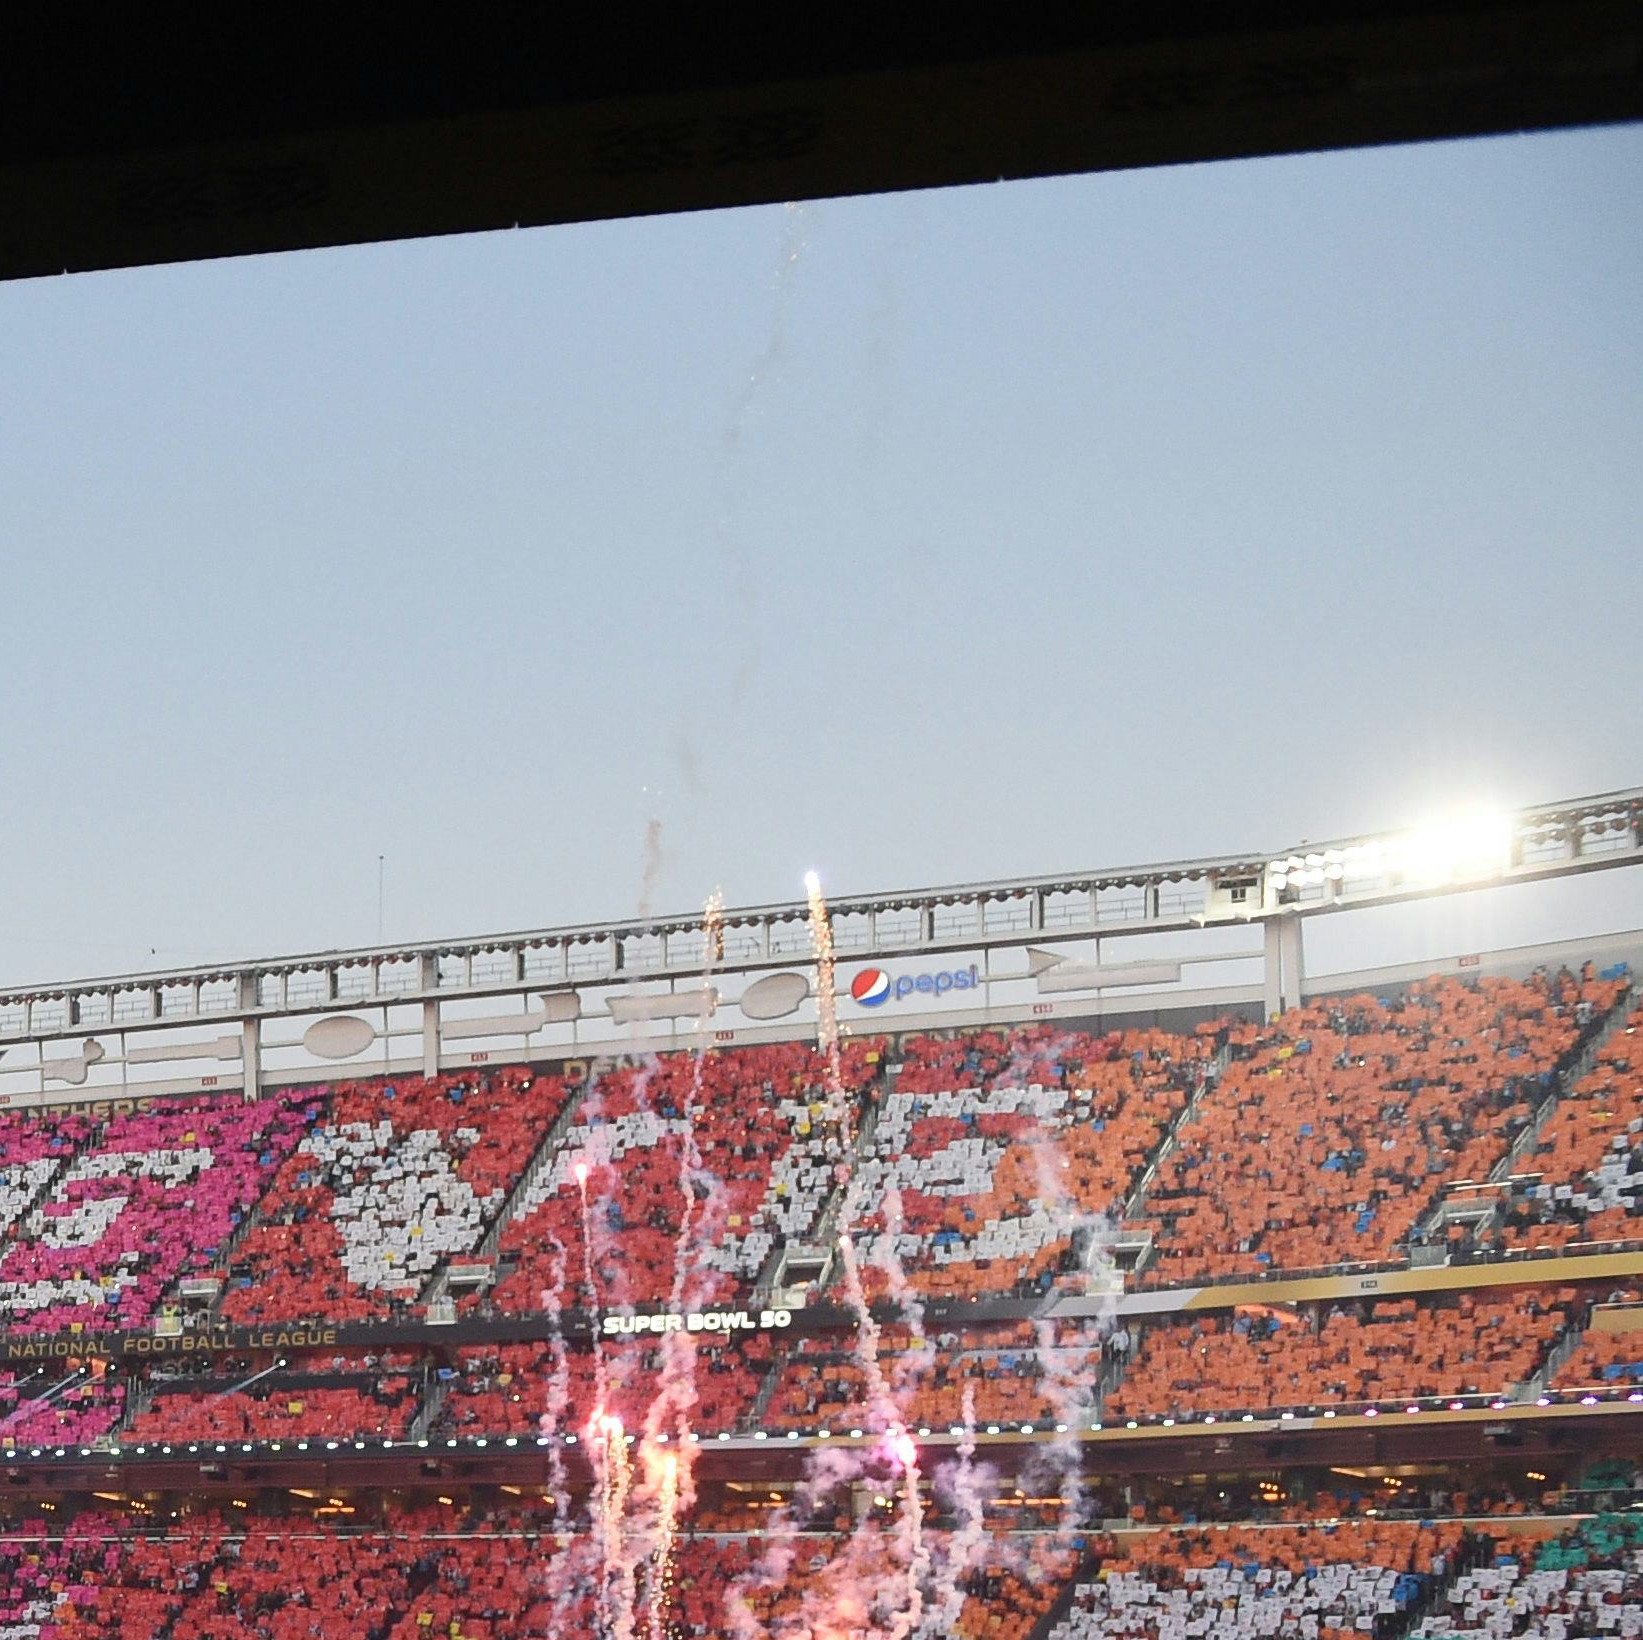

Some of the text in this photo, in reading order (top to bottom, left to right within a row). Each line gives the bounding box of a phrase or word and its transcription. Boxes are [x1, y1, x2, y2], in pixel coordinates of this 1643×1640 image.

[894, 963, 980, 1000] pepsi
[603, 1310, 791, 1334] SUPER BOWL 50
[8, 1330, 337, 1358] NATIONAL FOOTBALL LEAGUE
